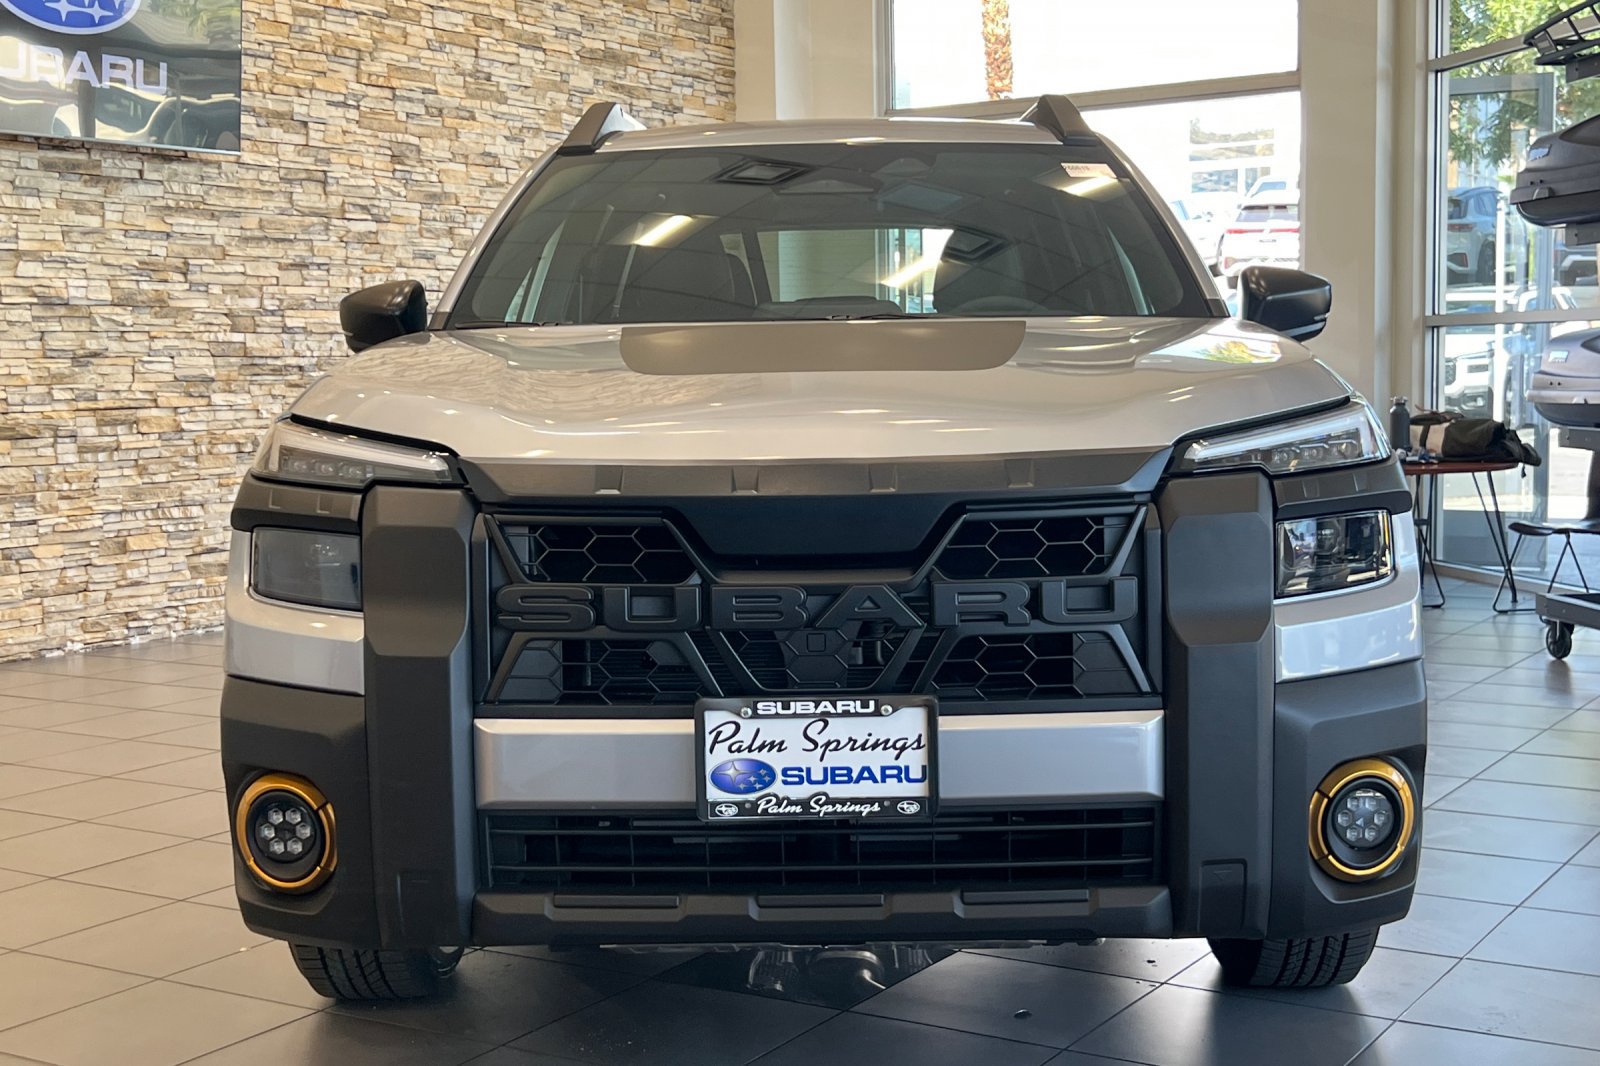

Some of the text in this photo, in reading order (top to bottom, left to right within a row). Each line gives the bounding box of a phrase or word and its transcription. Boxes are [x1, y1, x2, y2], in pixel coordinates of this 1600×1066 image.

[496, 576, 1138, 631] SUBARU
[756, 700, 875, 715] SUBARU
[708, 718, 926, 762] Palm Springs
[781, 765, 928, 786] SUBARU
[757, 795, 881, 817] Palm Springs
